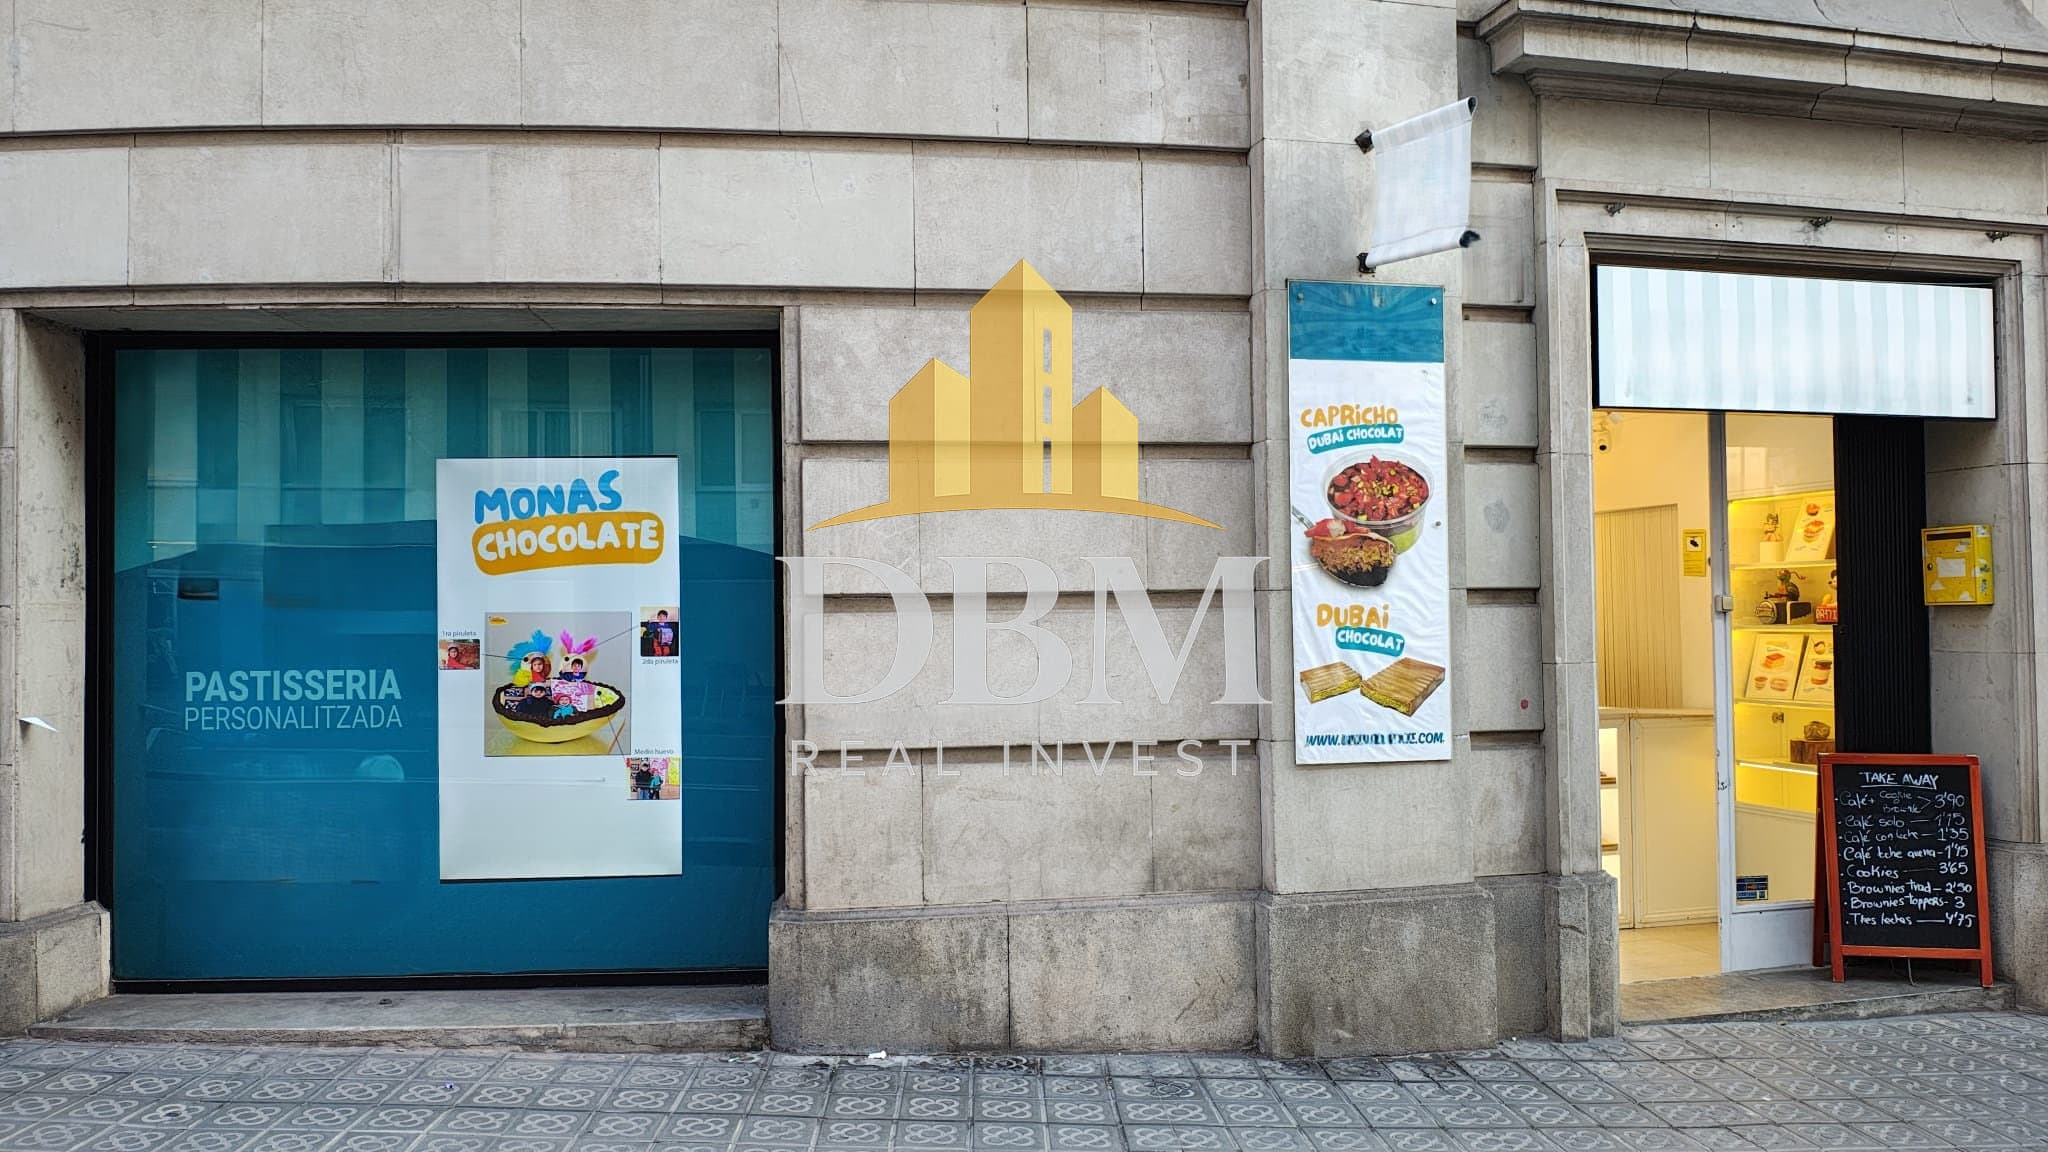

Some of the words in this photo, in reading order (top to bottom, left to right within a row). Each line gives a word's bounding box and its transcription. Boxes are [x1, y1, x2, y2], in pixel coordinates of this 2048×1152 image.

[1346, 425, 1403, 441] CHOCOLAT
[475, 470, 622, 524] MONAS
[477, 519, 660, 561] CHOCOLATE
[1336, 630, 1404, 651] CHOCOLAT
[185, 669, 402, 702] PASTISSERIA
[184, 704, 402, 731] PERSONALITZADA
[1859, 772, 1898, 785] TAKE
[1902, 773, 1939, 789] AWAY
[1845, 815, 1874, 829] Café
[1879, 816, 1905, 828] solo
[1843, 847, 1873, 865] Café
[1847, 881, 1905, 894] Brownies
[1850, 896, 1904, 909] Brownies
[1954, 896, 1965, 909] 3
